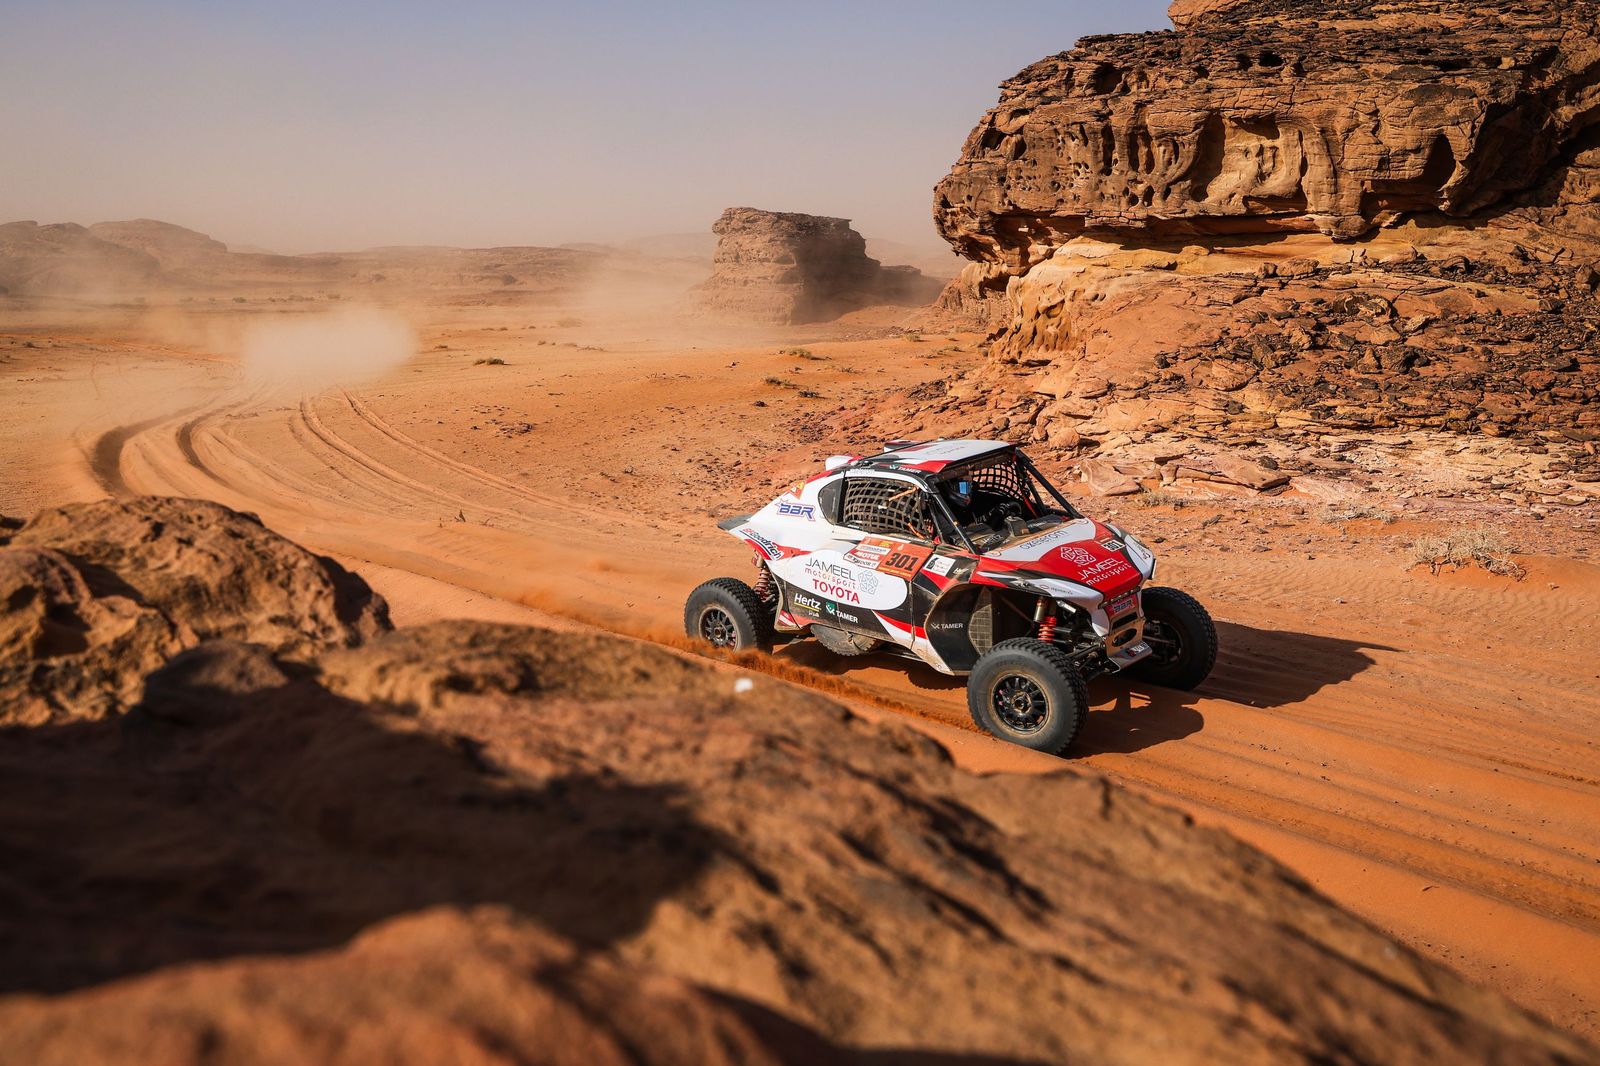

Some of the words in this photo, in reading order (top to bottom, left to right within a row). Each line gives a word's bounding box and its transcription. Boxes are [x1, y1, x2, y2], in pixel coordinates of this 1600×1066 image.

[779, 503, 814, 519] BBR
[854, 551, 880, 560] MOTUL
[885, 552, 919, 571] 301
[804, 567, 856, 589] motorsport
[805, 557, 856, 581] JAMEEL
[1078, 557, 1124, 580] JAMEEL
[1086, 563, 1132, 586] motorsport
[794, 593, 821, 609] Hertz
[812, 578, 860, 604] TOYOTA
[836, 610, 859, 623] TAMER
